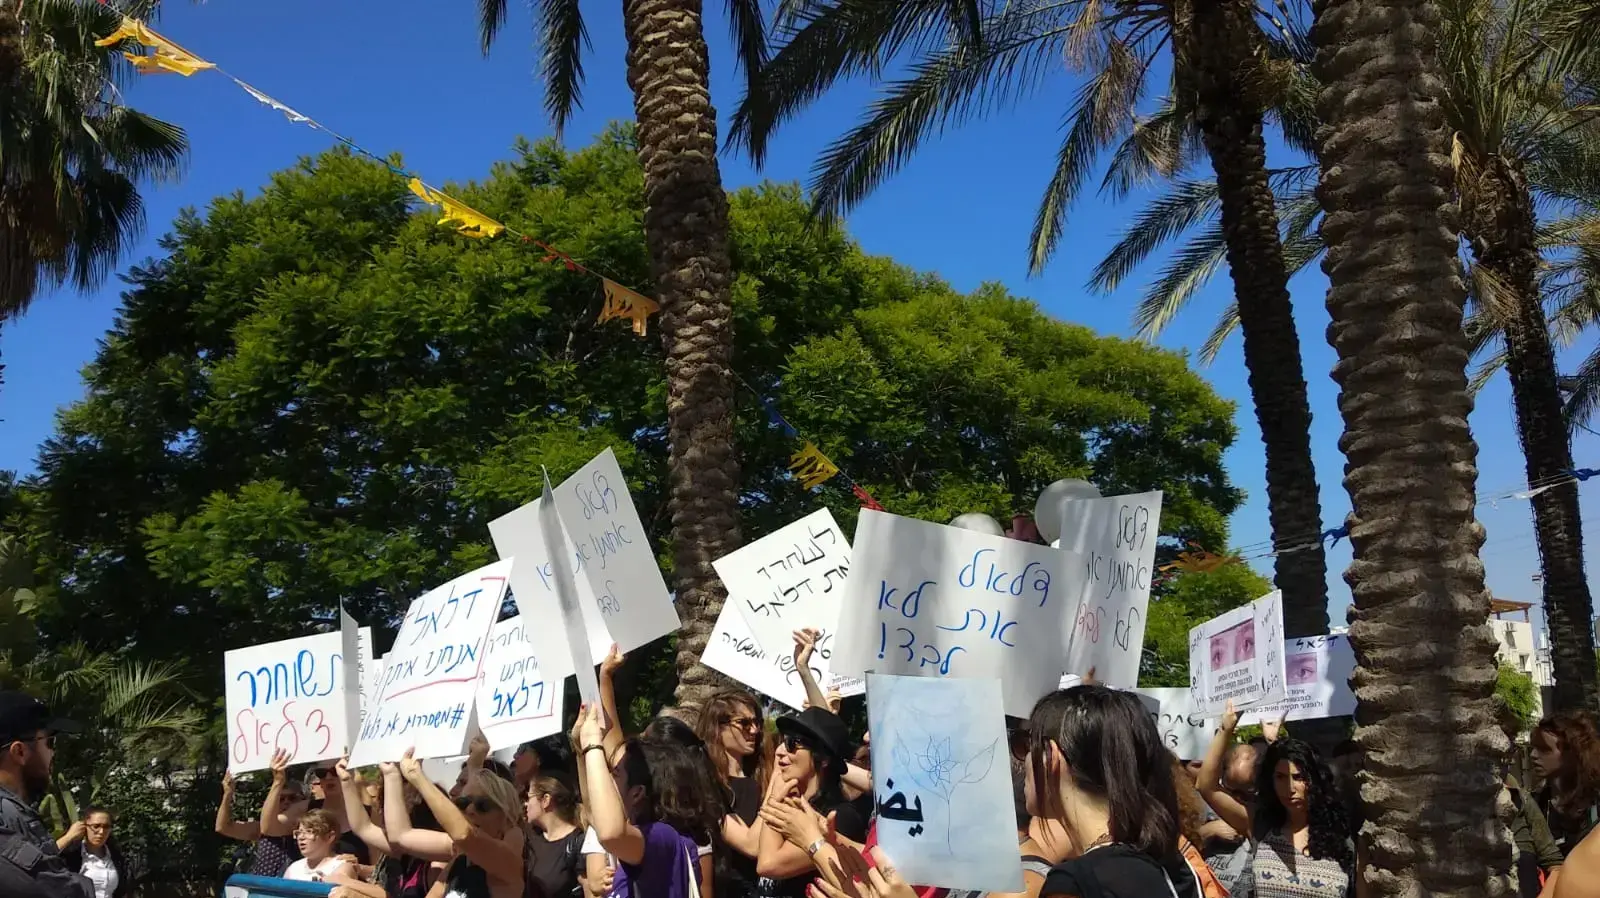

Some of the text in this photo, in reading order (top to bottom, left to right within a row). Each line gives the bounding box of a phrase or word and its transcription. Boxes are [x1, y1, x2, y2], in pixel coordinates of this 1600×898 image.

[756, 525, 836, 580] לשחרר
[746, 555, 851, 619] את דלאל
[877, 548, 1051, 619] דלאל לא
[409, 584, 484, 647] דלאל
[935, 608, 1019, 648] את
[1112, 606, 1141, 652] לא
[1296, 635, 1339, 650] דלאל
[423, 636, 482, 677] אנחנו
[500, 655, 539, 683] חותנו
[877, 621, 968, 675] לבד!
[236, 650, 343, 708] תשוחרר
[233, 701, 331, 765] דלאל
[875, 777, 924, 837] يض
